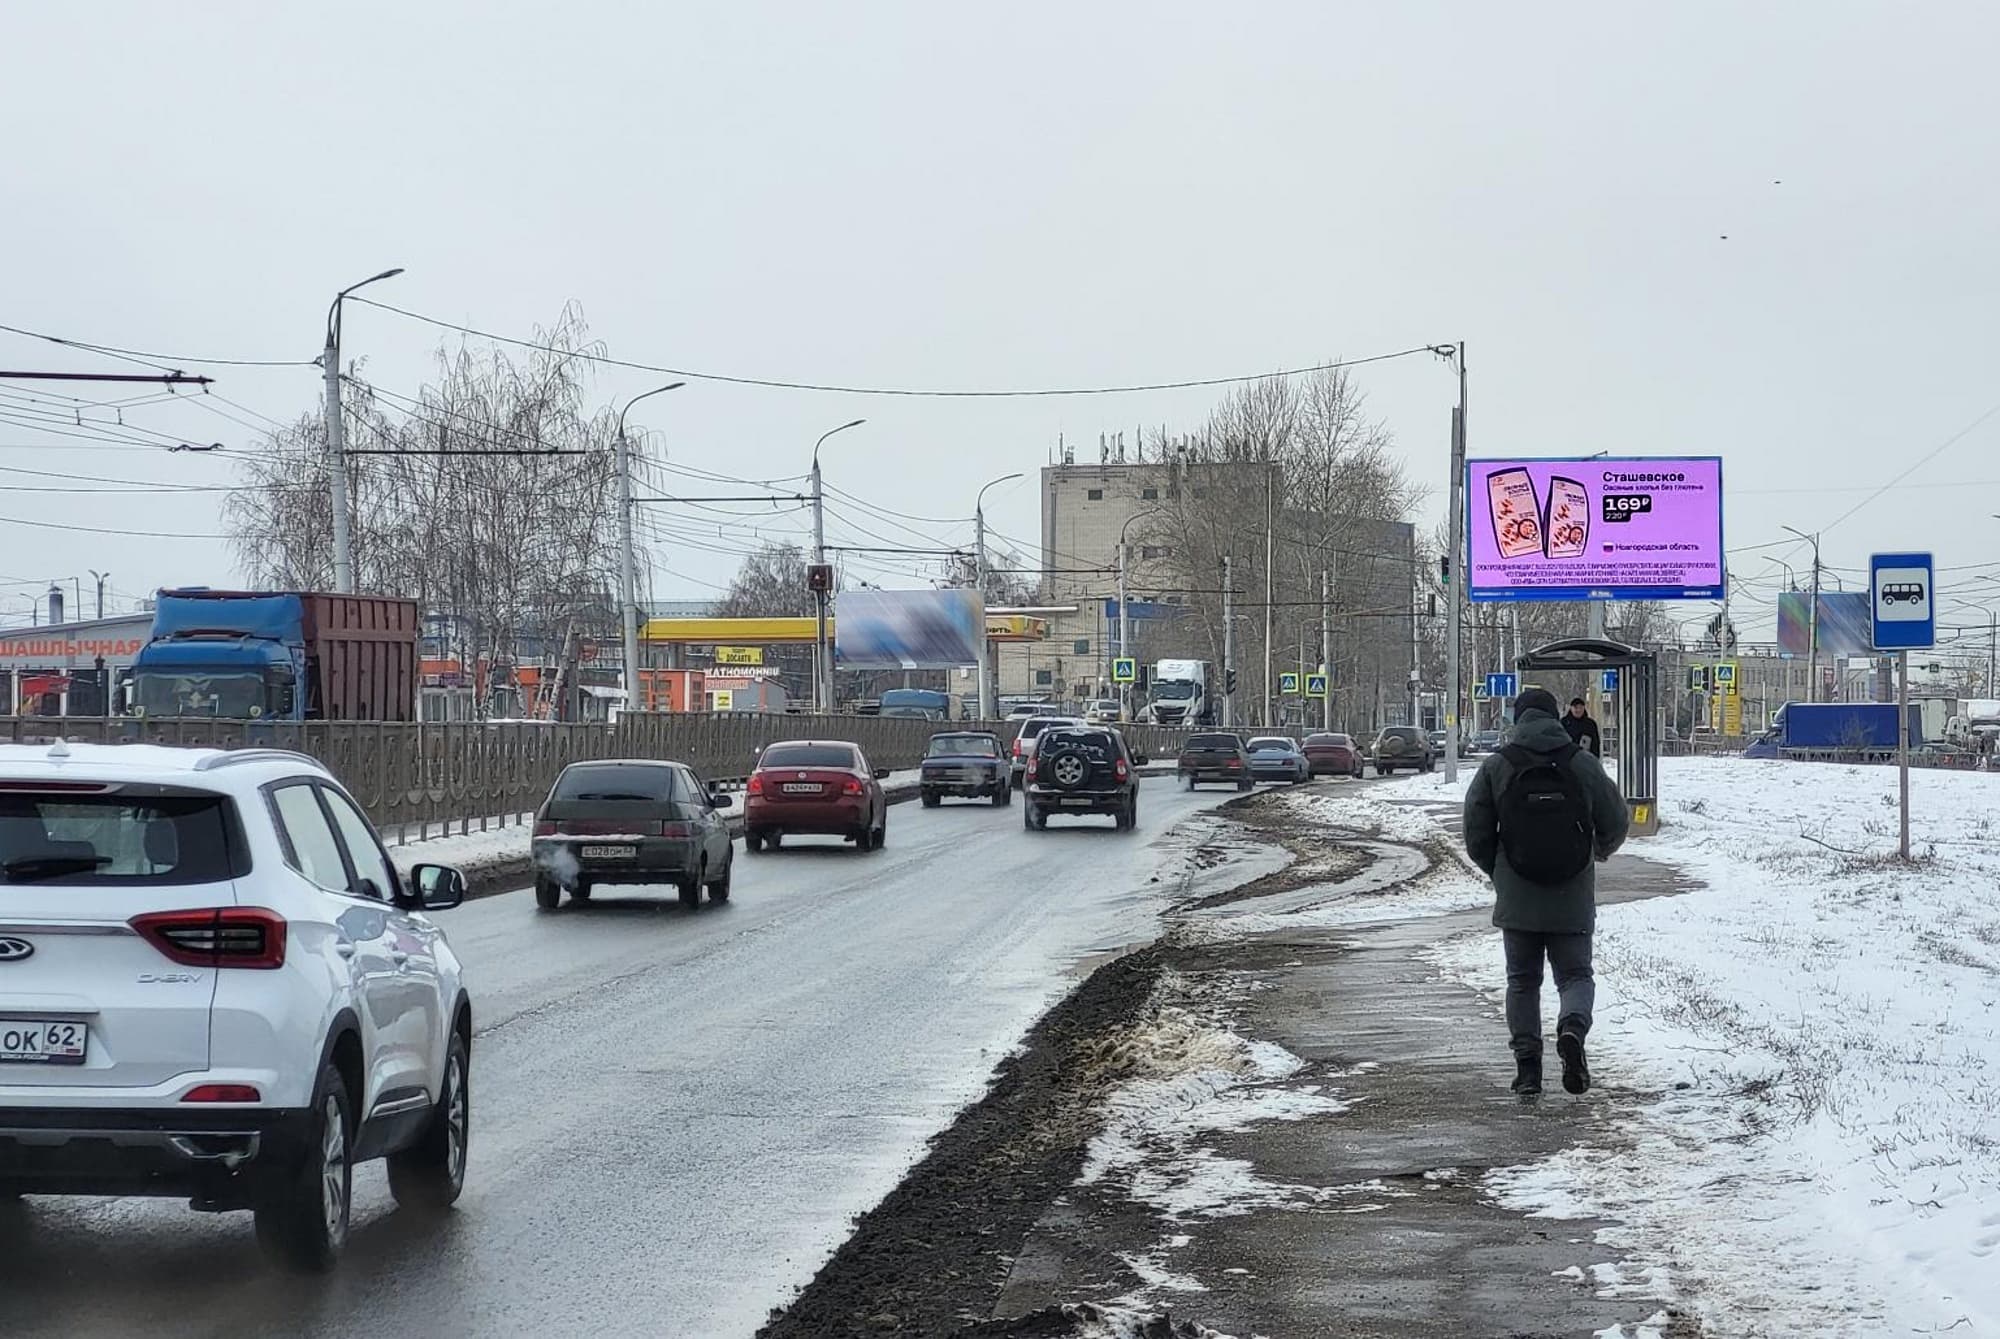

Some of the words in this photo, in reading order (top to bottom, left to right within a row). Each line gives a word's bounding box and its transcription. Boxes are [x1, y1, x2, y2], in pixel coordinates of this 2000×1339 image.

[1602, 471, 1685, 482] Сташевское
[1615, 543, 1667, 552] Новгородская
[1669, 543, 1699, 551] область
[0, 640, 141, 656] ШАШЛЫЧНАЯ
[47, 1025, 75, 1046] 62
